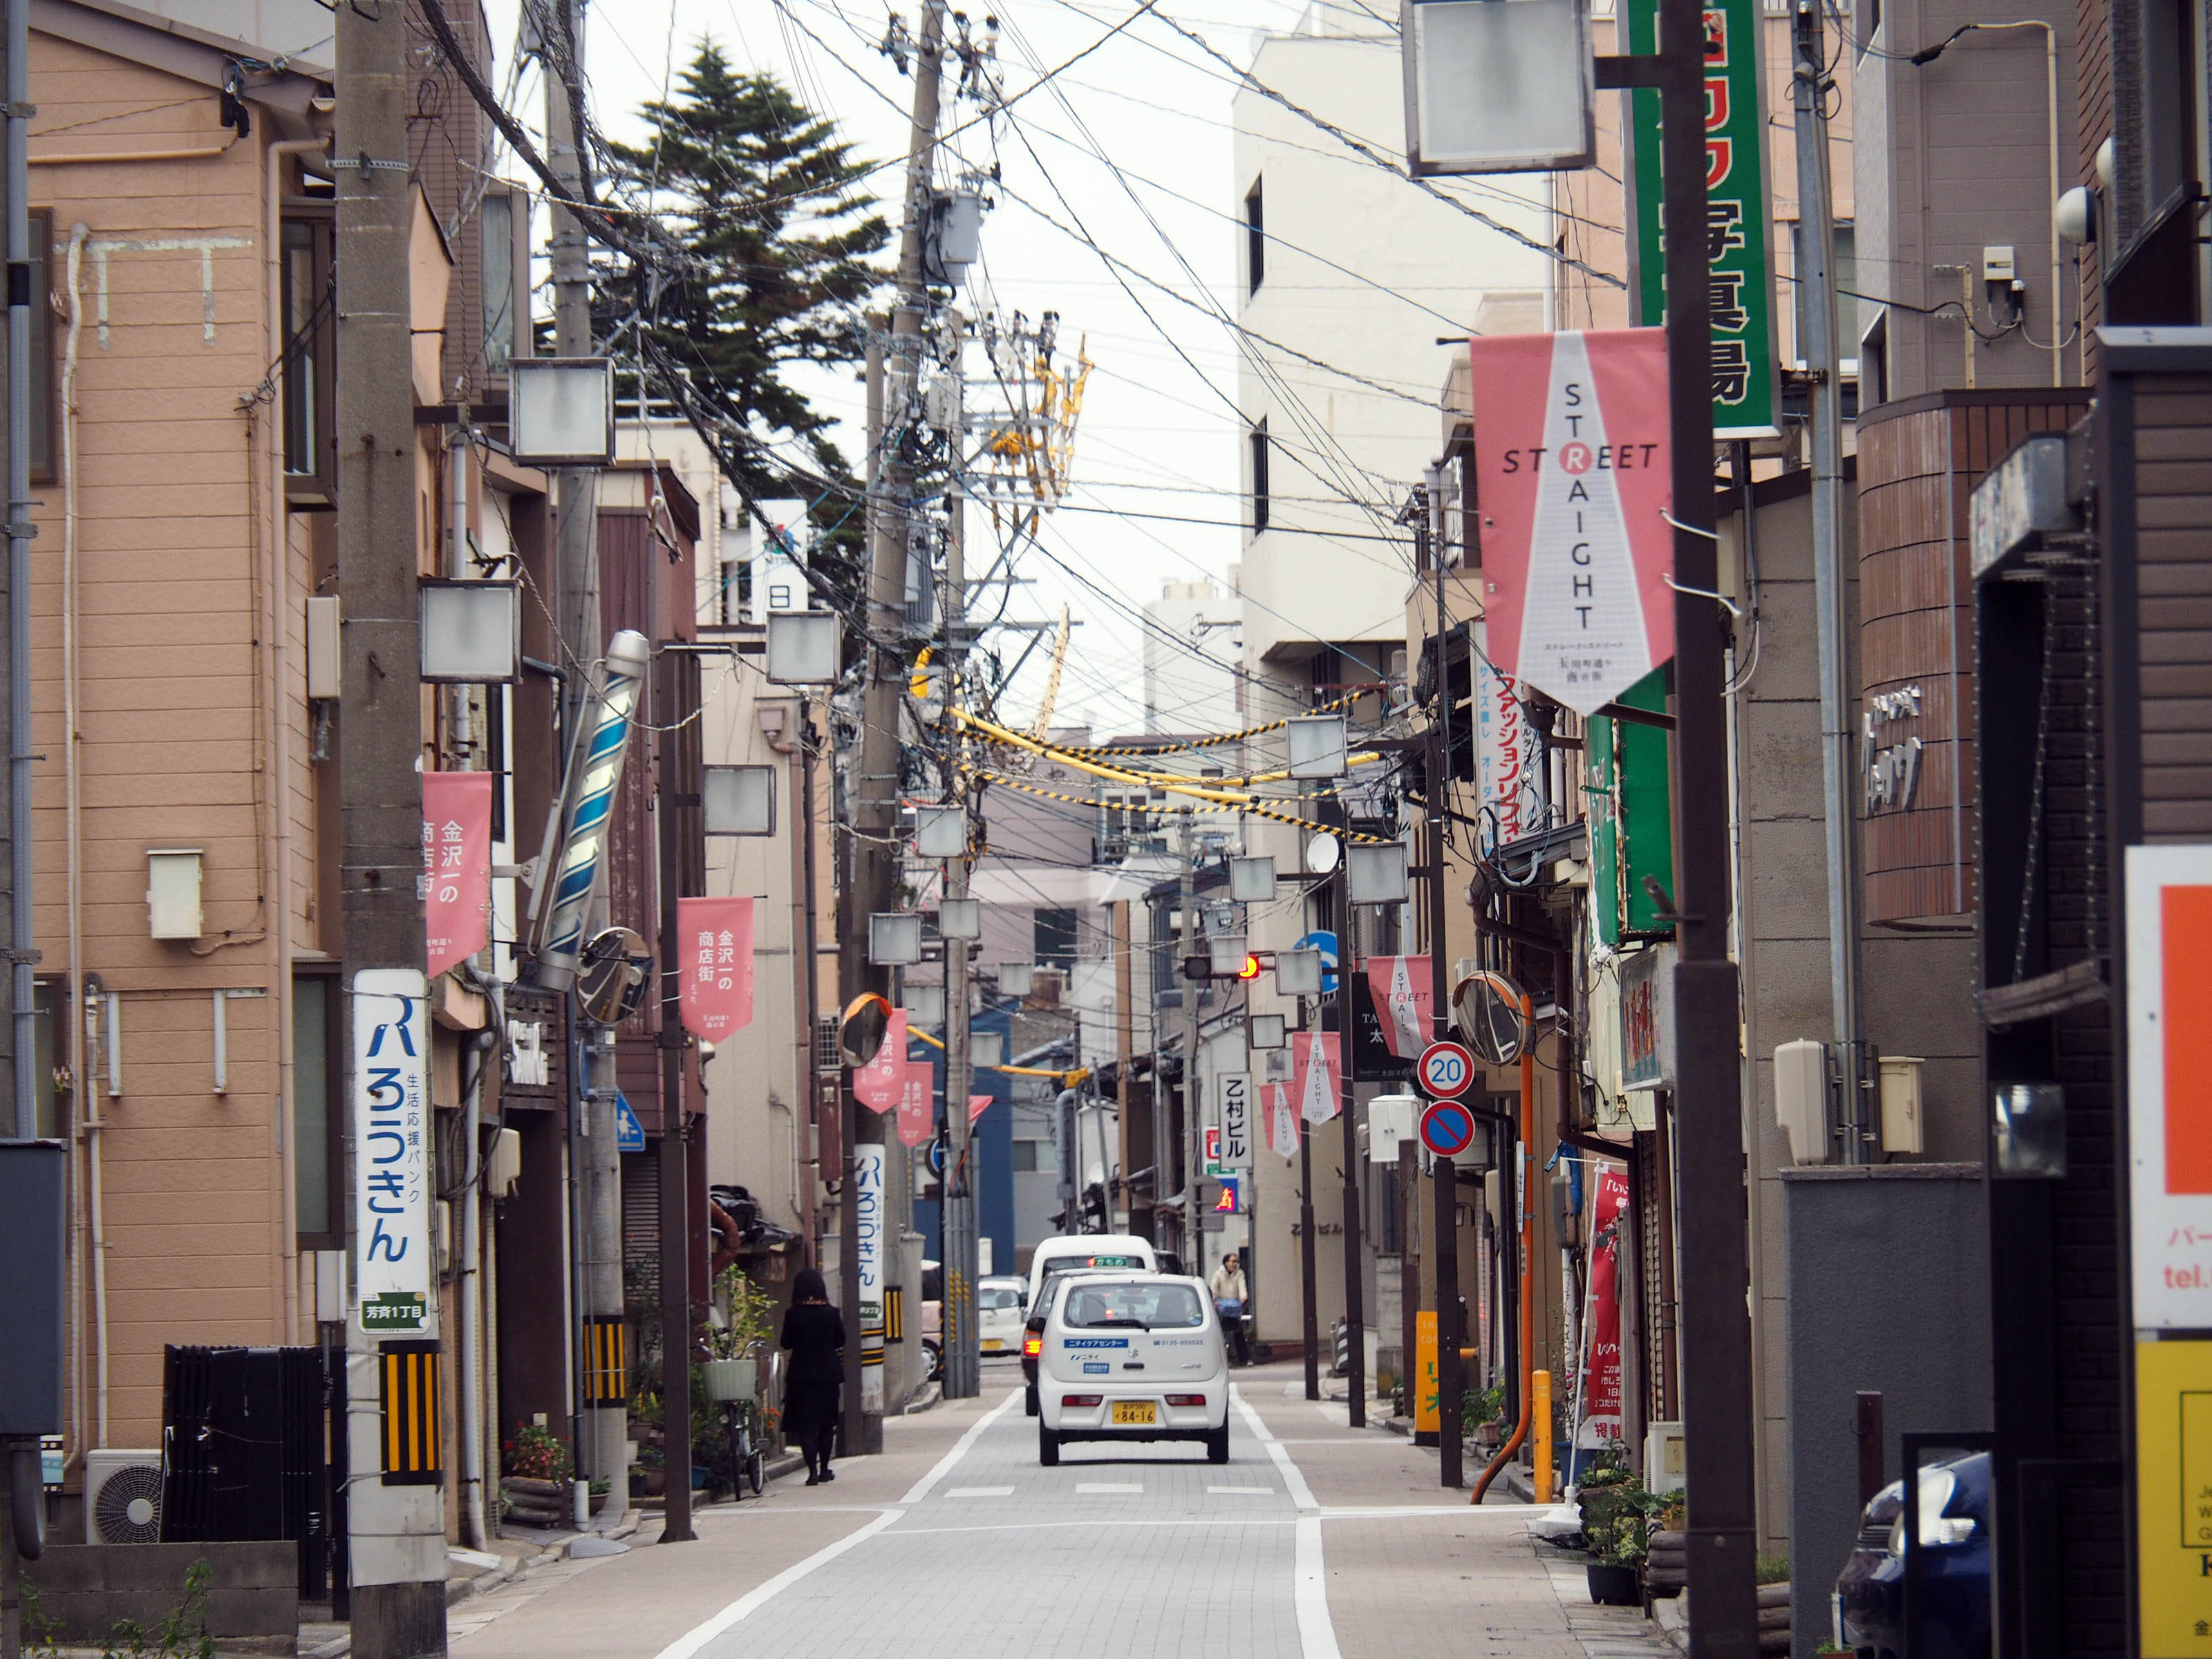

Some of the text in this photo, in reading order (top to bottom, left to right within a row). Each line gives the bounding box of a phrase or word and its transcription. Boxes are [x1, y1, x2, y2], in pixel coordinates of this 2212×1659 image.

[1502, 443, 1658, 474] STREET
[1564, 383, 1593, 630] STRAIGHT
[439, 820, 463, 903] 金沢一の
[697, 930, 714, 982] 商店街
[718, 930, 733, 991] 金沢一の
[1431, 1058, 1461, 1082] 20
[1226, 1079, 1246, 1159] 乙村ビル
[366, 1068, 408, 1263] ろうきん
[2164, 1264, 2212, 1288] tel.
[1068, 1340, 1124, 1348] ニチイケアセンター
[1606, 1388, 1620, 1397] 1日
[1122, 1410, 1154, 1422] 84-16
